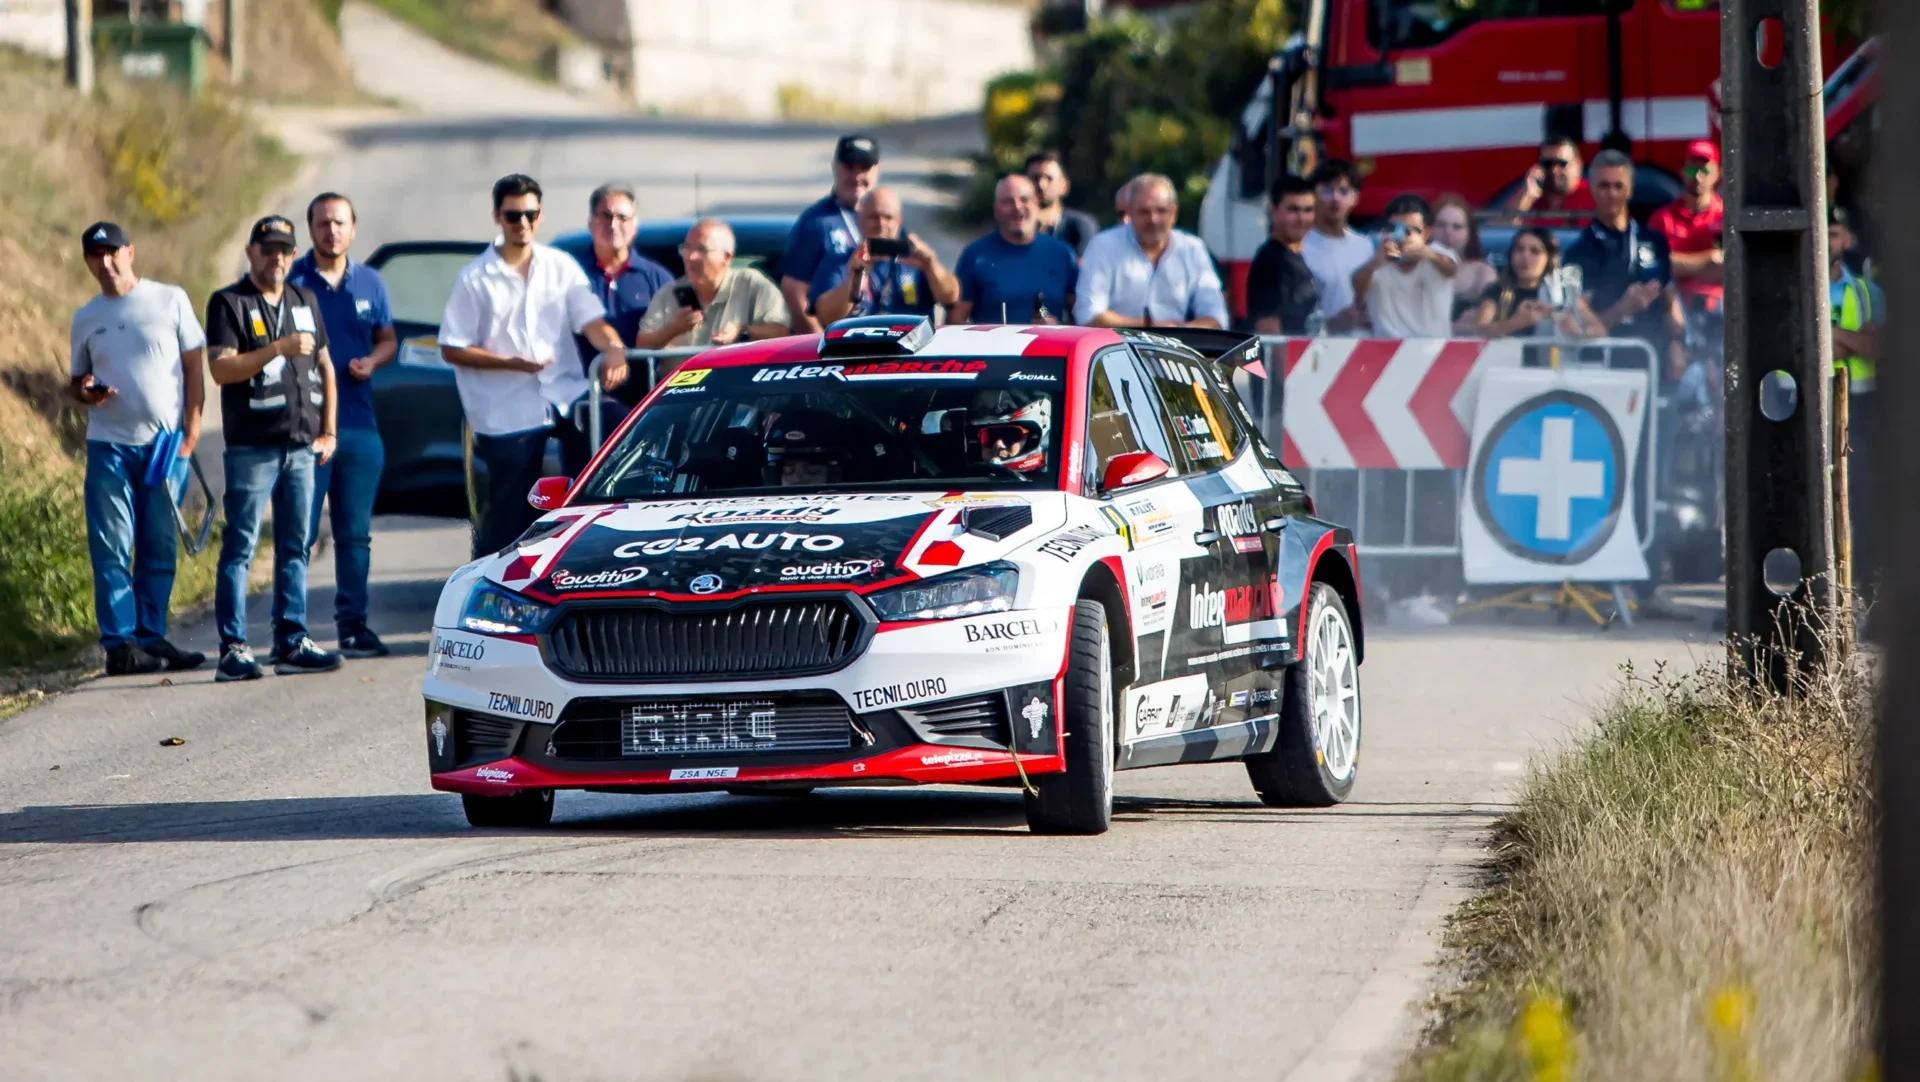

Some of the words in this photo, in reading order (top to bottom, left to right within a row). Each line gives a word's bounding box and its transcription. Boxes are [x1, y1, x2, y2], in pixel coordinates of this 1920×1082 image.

[704, 532, 844, 552] AUTO
[488, 691, 554, 720] TECNILOURO
[852, 677, 947, 709] TECNILOURO
